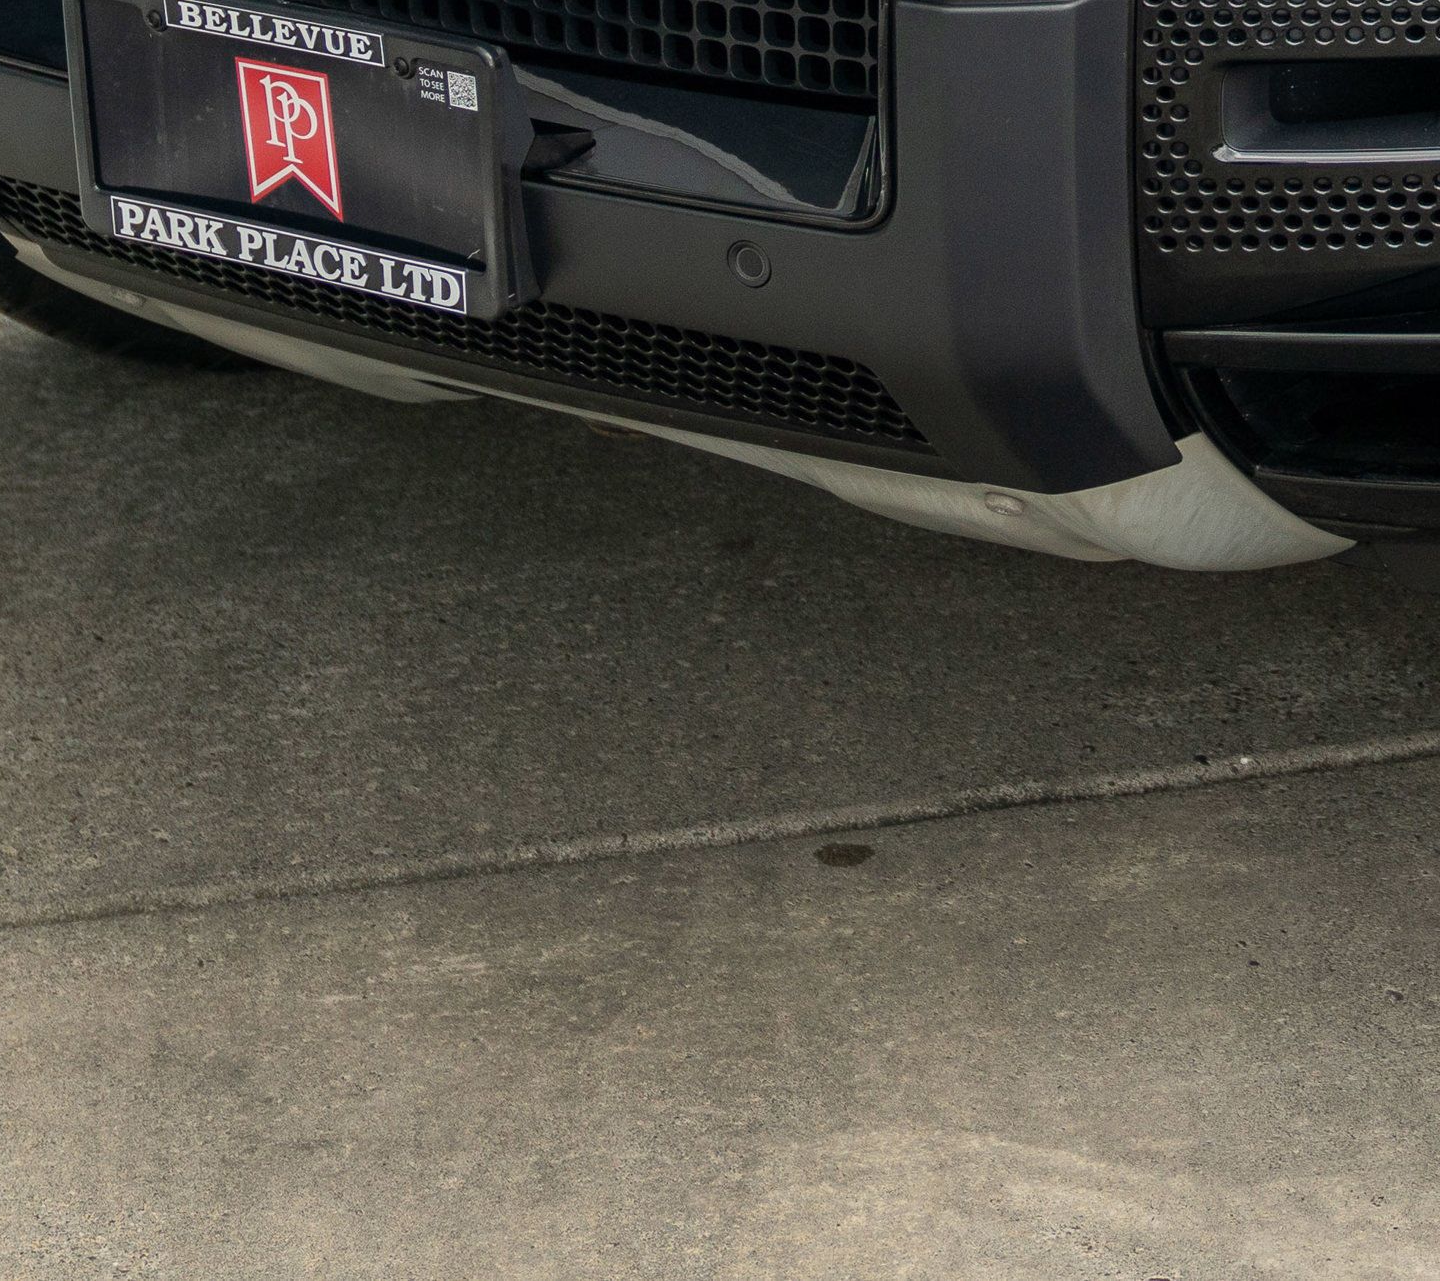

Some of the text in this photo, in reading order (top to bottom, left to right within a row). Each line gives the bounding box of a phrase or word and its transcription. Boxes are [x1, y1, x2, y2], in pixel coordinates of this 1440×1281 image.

[178, 1, 375, 61] BELLEVUE
[418, 66, 444, 79] SCAN
[420, 78, 445, 91] TO SEE
[420, 89, 446, 103] MORE
[117, 200, 461, 308] PARK PLACE LTD
